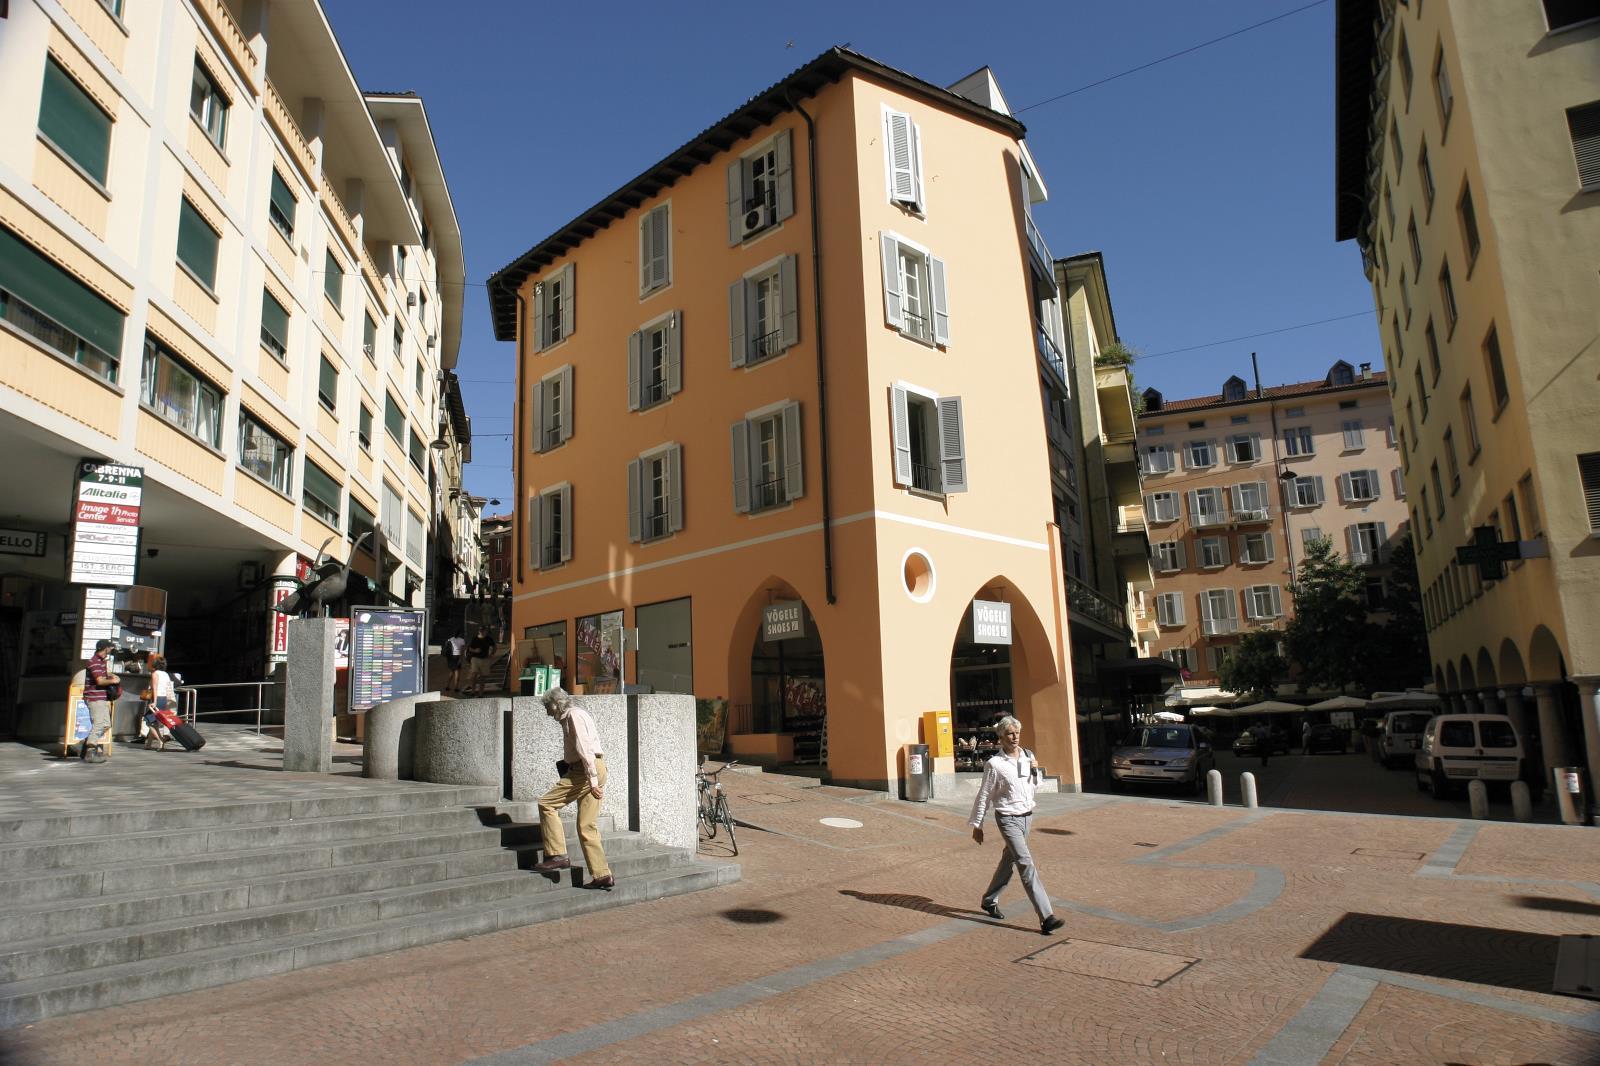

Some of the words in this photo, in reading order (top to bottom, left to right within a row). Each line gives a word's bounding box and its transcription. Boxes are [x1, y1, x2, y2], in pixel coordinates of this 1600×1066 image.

[83, 463, 142, 478] CABRENNA
[81, 487, 128, 499] Alitalia
[78, 511, 107, 521] Center
[81, 503, 109, 514] Image
[111, 505, 121, 515] 1h
[121, 510, 138, 518] Photo
[767, 608, 799, 623] VÖGELE
[977, 606, 1007, 624] VÖGELE
[768, 622, 791, 635] SHOES
[977, 623, 1000, 637] SHOES
